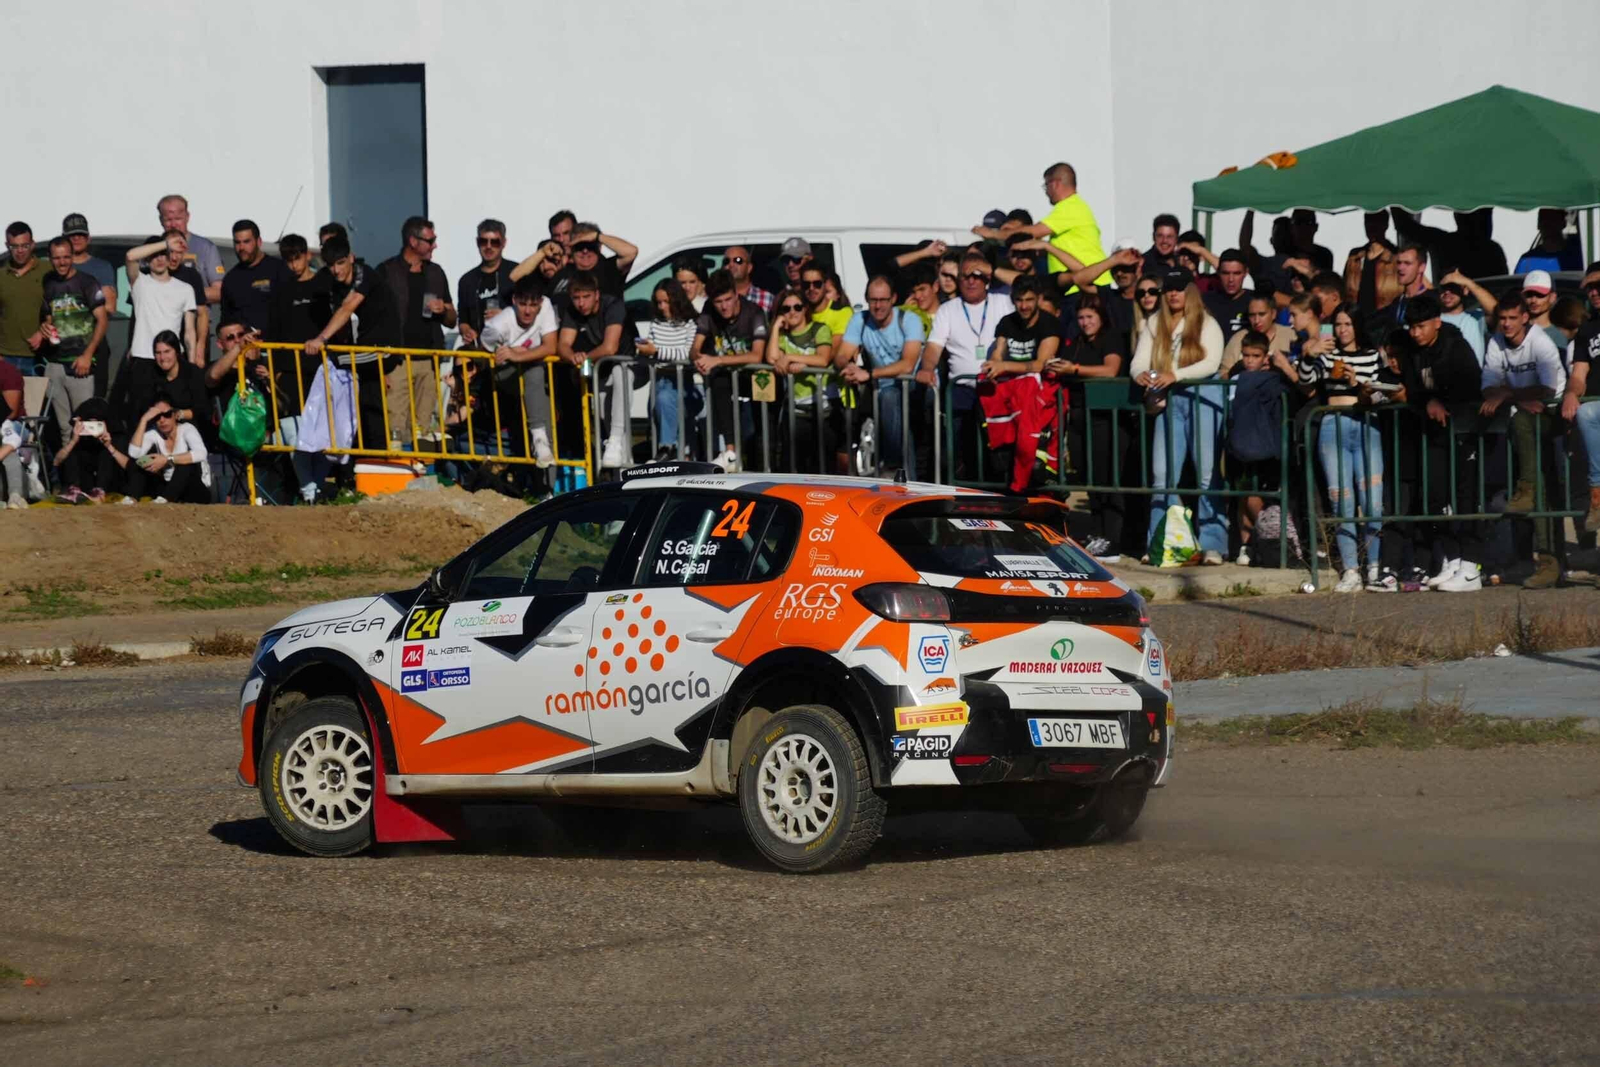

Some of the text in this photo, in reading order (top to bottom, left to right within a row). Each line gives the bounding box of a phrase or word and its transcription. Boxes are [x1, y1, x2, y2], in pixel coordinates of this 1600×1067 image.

[627, 466, 679, 476] MAVISA SPORT
[711, 499, 756, 539] 24
[809, 528, 835, 542] GSI
[812, 566, 864, 578] INOXMAN
[985, 570, 1090, 580] MAVISA SPORT
[778, 583, 847, 609] RGS
[454, 613, 517, 628] POZOBLANCO
[774, 607, 836, 623] europe
[288, 617, 385, 643] SUTEGA
[406, 608, 444, 639] 24
[923, 646, 945, 657] ICA
[1009, 662, 1103, 673] MADERAS VAZQUEZ
[441, 675, 469, 685] ORSSO
[899, 707, 964, 726] PIRELLI
[1041, 722, 1083, 743] 3067
[1088, 723, 1118, 744] MBF
[907, 737, 949, 751] PAGID
